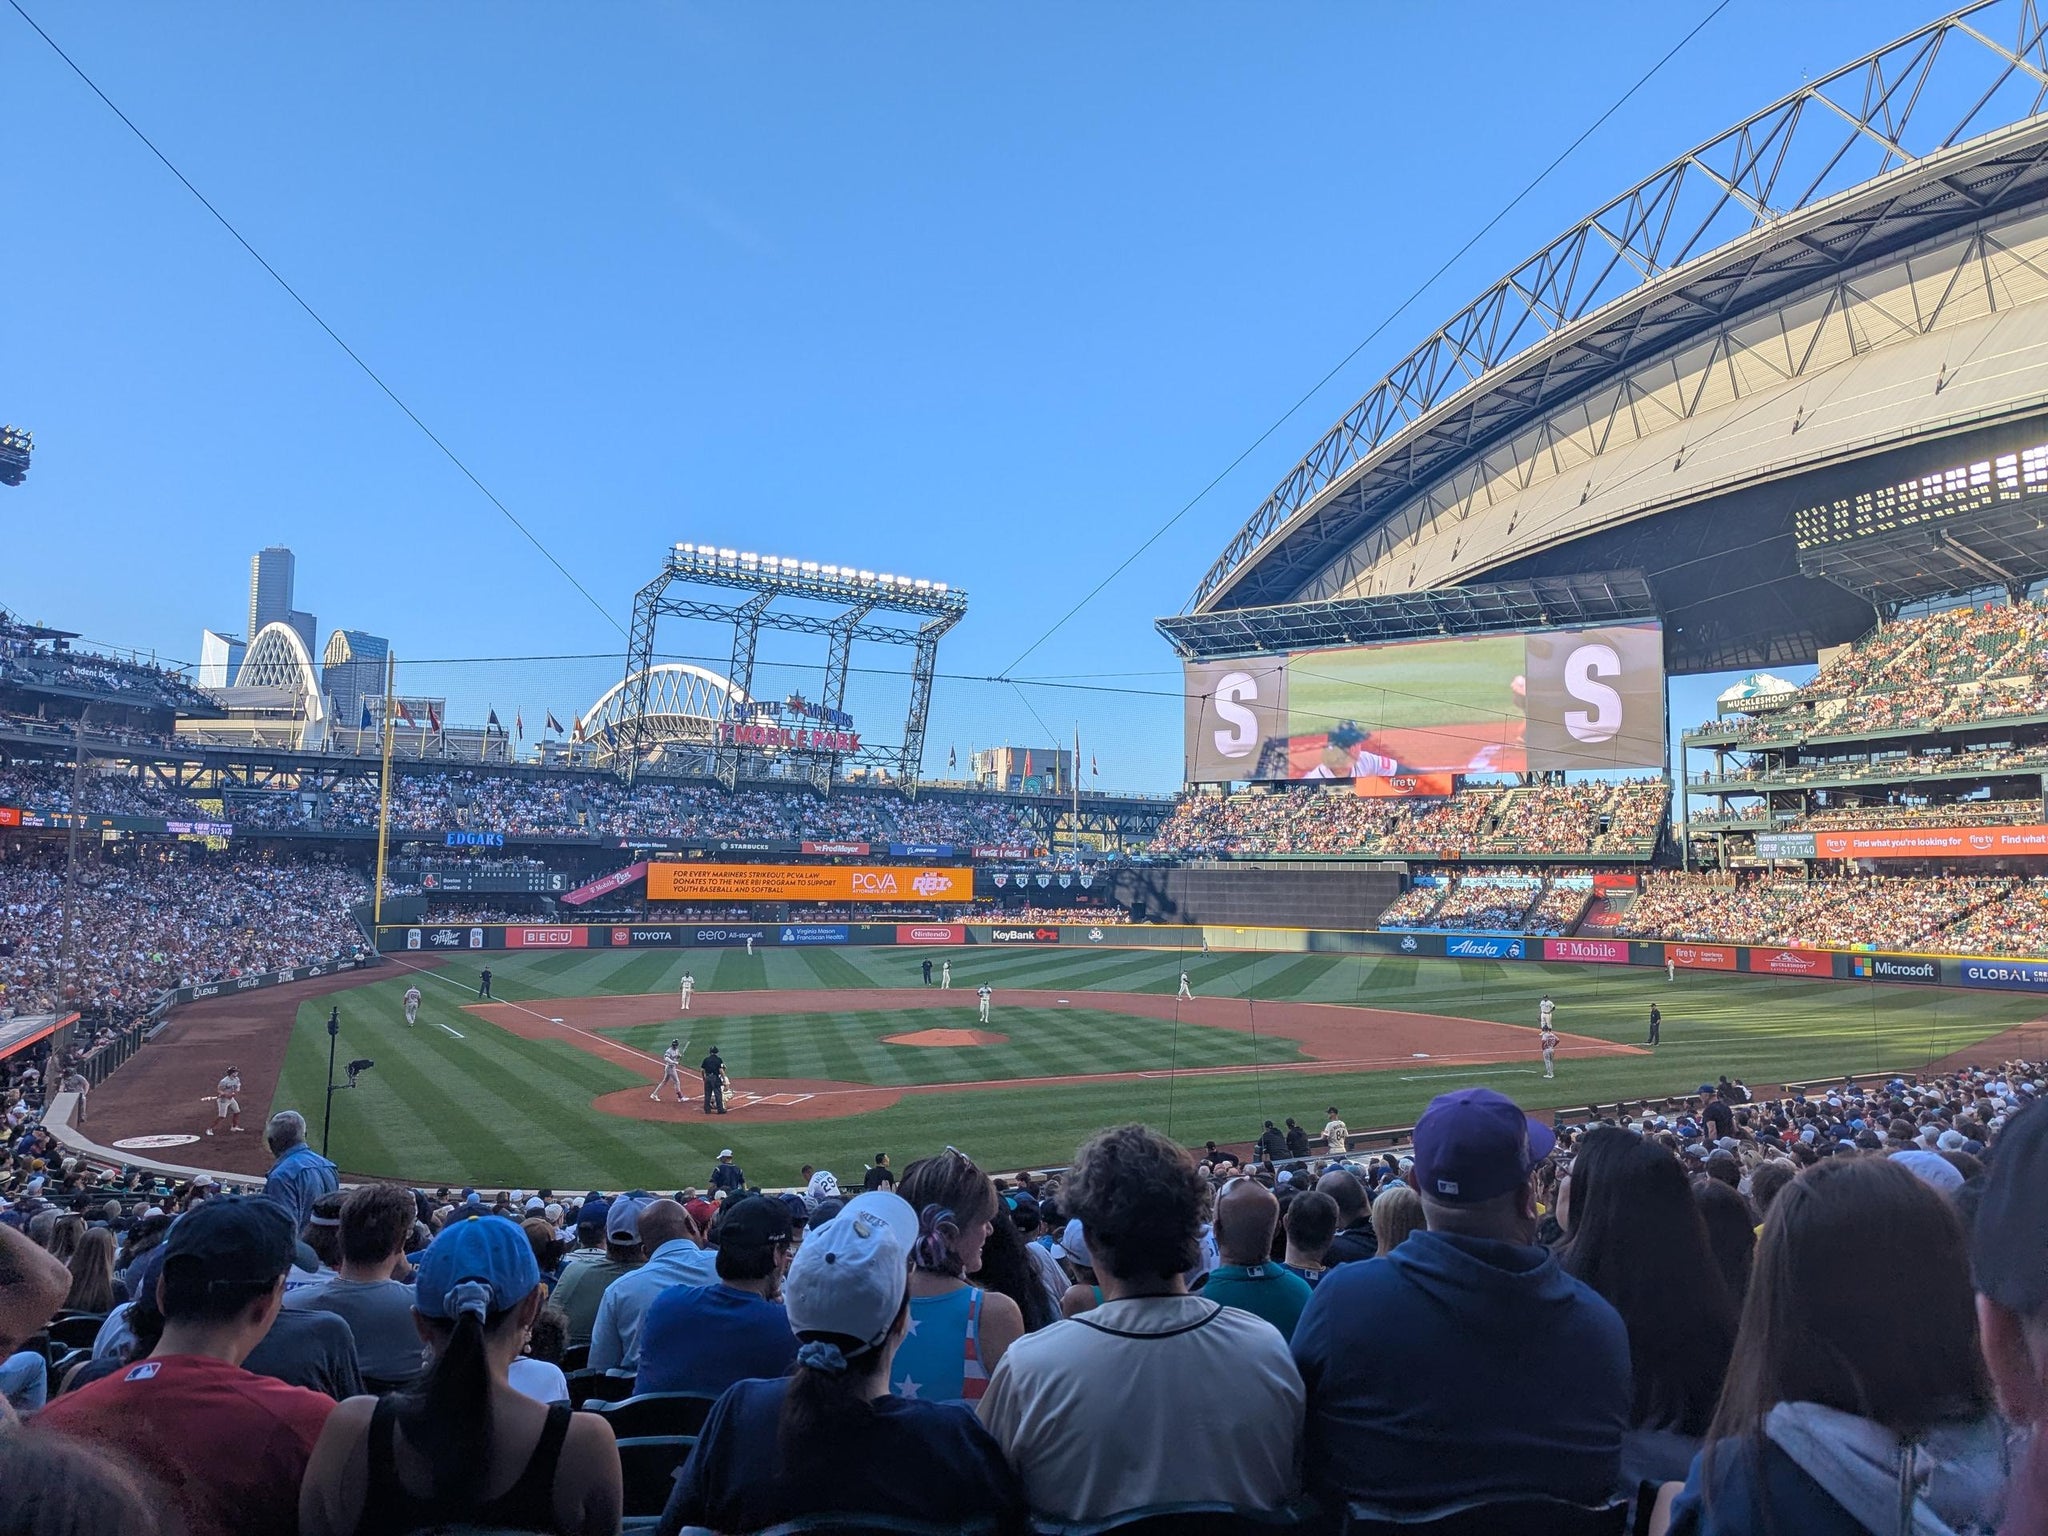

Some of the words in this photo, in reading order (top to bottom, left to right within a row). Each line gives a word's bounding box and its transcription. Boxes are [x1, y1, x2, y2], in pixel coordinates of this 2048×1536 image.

[72, 666, 97, 677] Trident
[1564, 643, 1623, 744] S
[1727, 693, 1791, 708] MUCKLESHOOT
[733, 701, 781, 718] SEATTLE
[806, 702, 854, 728] MARINERS
[1213, 671, 1258, 759] S
[812, 729, 862, 751] PARK
[1390, 778, 1406, 786] fire
[1407, 778, 1416, 786] tv
[1892, 838, 1916, 848] you're
[1918, 838, 1946, 848] looking
[1969, 836, 1983, 844] fire
[2002, 835, 2020, 844] Find
[2022, 834, 2044, 843] what
[527, 932, 568, 942] BECU
[632, 932, 672, 940] TOYOTA
[697, 931, 726, 940] eero
[993, 930, 1035, 940] KeyBank
[1451, 940, 1498, 955] Alaska
[1556, 943, 1566, 955] T
[1571, 943, 1616, 957] Mobile
[1676, 948, 1688, 956] fire
[1689, 949, 1696, 958] tv
[1875, 962, 1934, 976] Microsoft
[278, 971, 294, 983] STIHL
[1968, 968, 2030, 982] GLOBAL
[238, 979, 249, 988] Great
[200, 986, 218, 996] LEXUS
[1336, 1130, 1345, 1140] 84
[821, 1176, 835, 1192] 29
